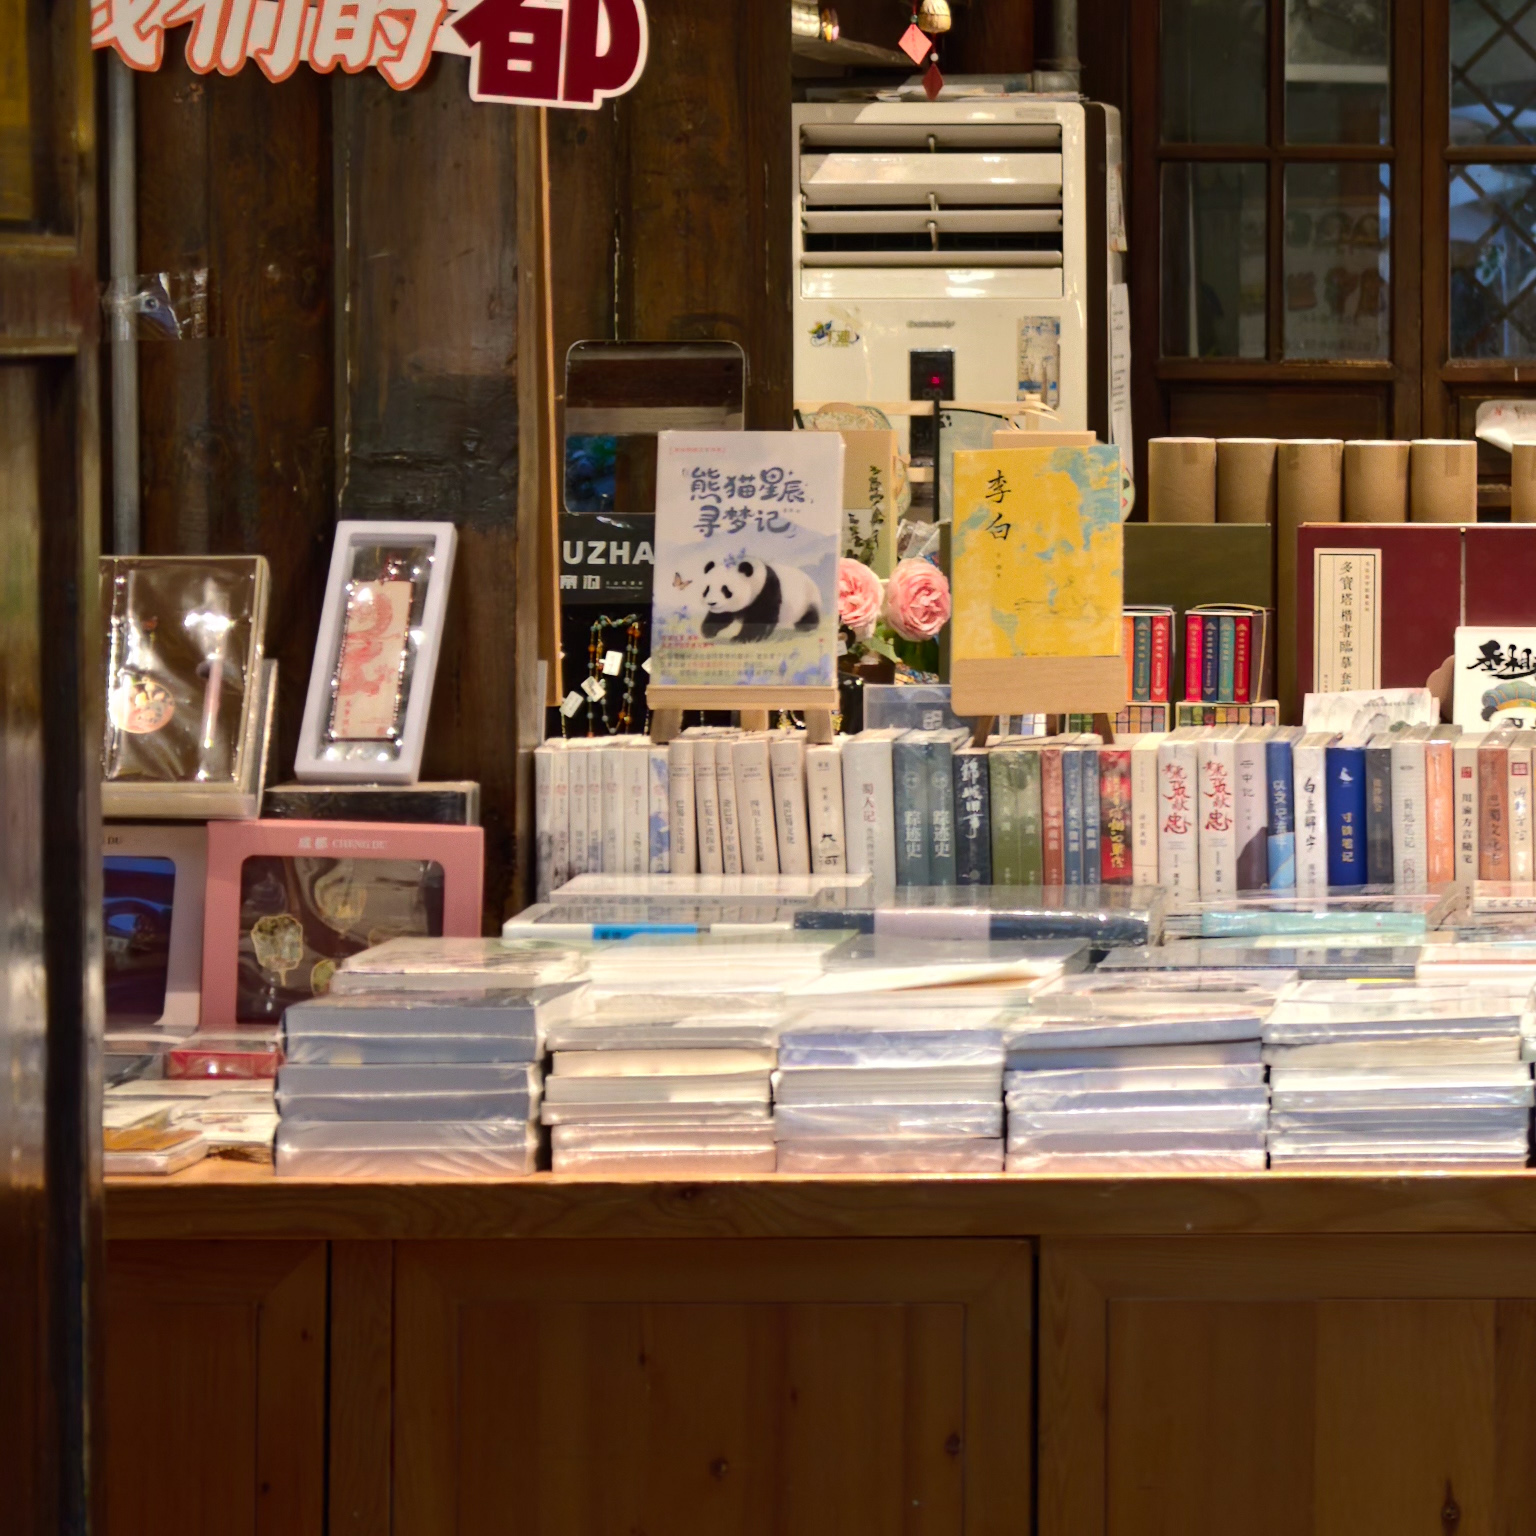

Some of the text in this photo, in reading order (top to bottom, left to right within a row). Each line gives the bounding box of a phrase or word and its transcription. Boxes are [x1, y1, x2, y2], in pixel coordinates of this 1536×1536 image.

[690, 466, 806, 504] 熊猫星辰
[694, 505, 791, 538] 寻梦记
[984, 469, 1012, 544] 李白
[562, 540, 655, 565] UZHA
[298, 836, 329, 850] 成都
[1461, 793, 1473, 864] 川渝方言随笔
